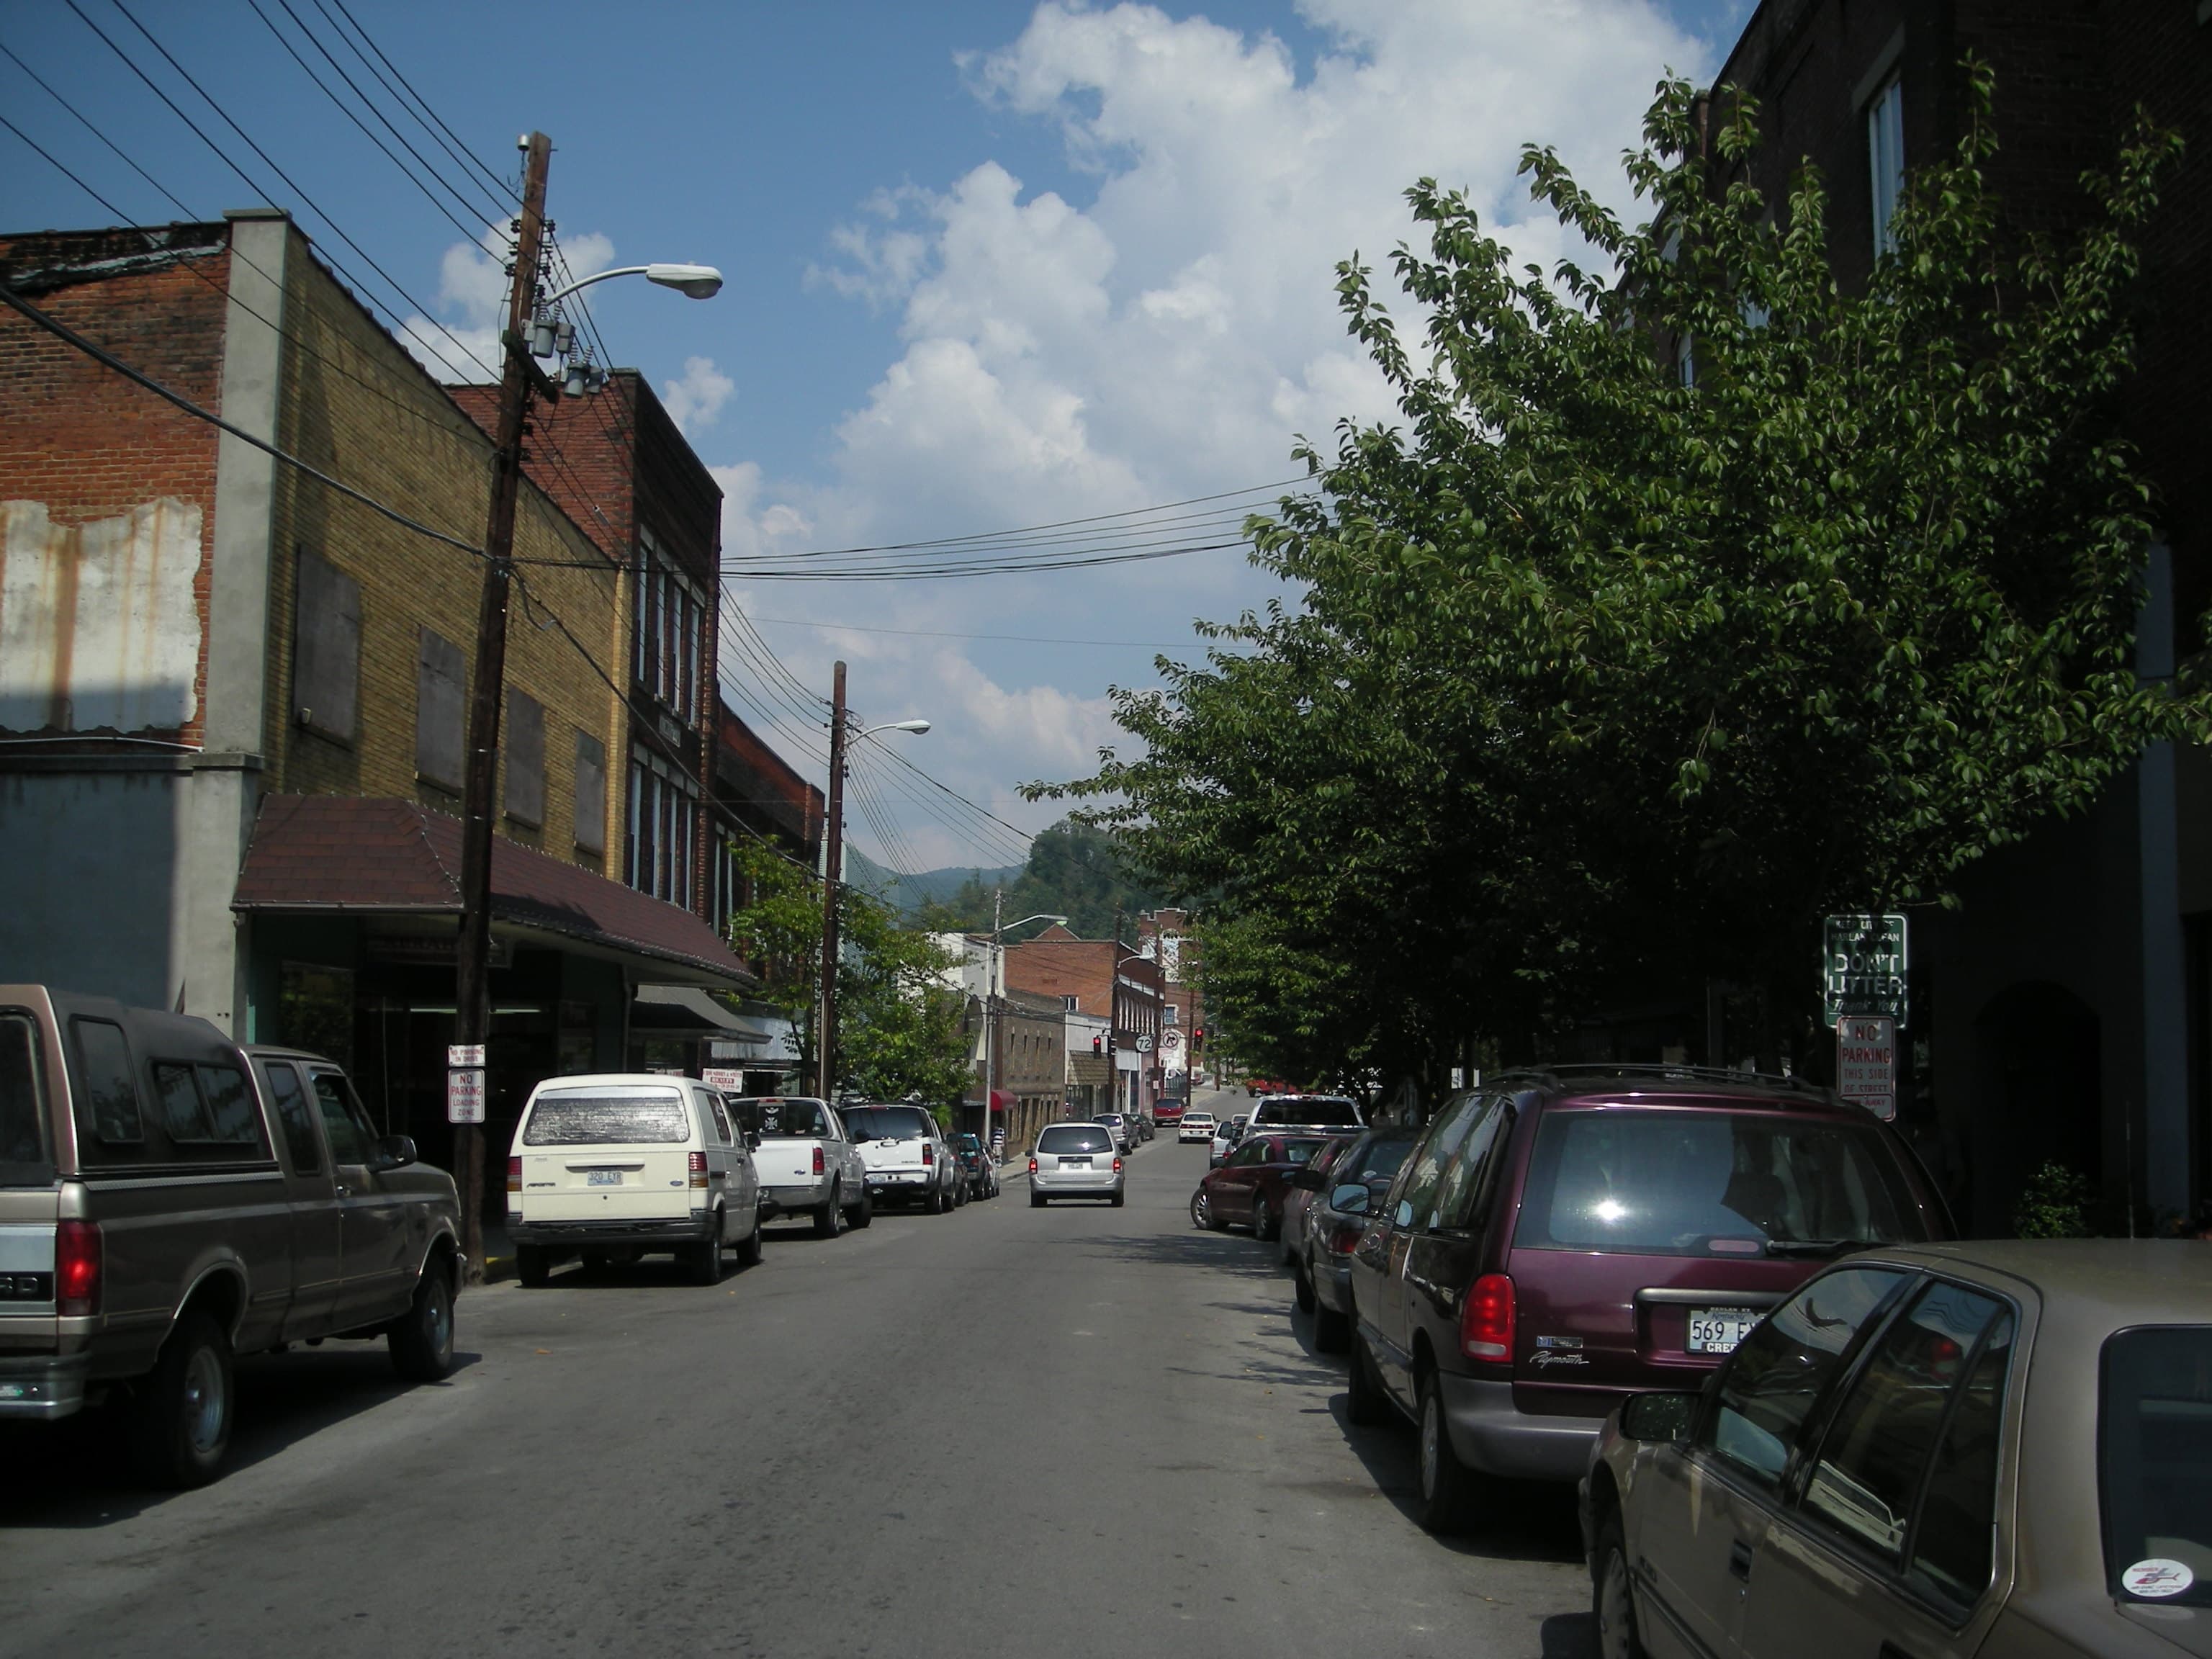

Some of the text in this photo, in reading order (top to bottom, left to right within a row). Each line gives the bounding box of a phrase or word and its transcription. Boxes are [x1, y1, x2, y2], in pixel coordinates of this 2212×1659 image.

[1834, 953, 1899, 973] DON'T
[1828, 975, 1903, 995] LITTER
[1855, 1025, 1878, 1041] NO
[1137, 1038, 1151, 1050] 72
[1842, 1047, 1891, 1064] PARKING
[459, 1074, 473, 1084] NO
[1843, 1068, 1889, 1080] THIS SIDE
[450, 1086, 482, 1095] PARKING
[1858, 1084, 1888, 1093] STREET
[1692, 1320, 1725, 1341] 569
[1529, 1350, 1590, 1370] Plymouth
